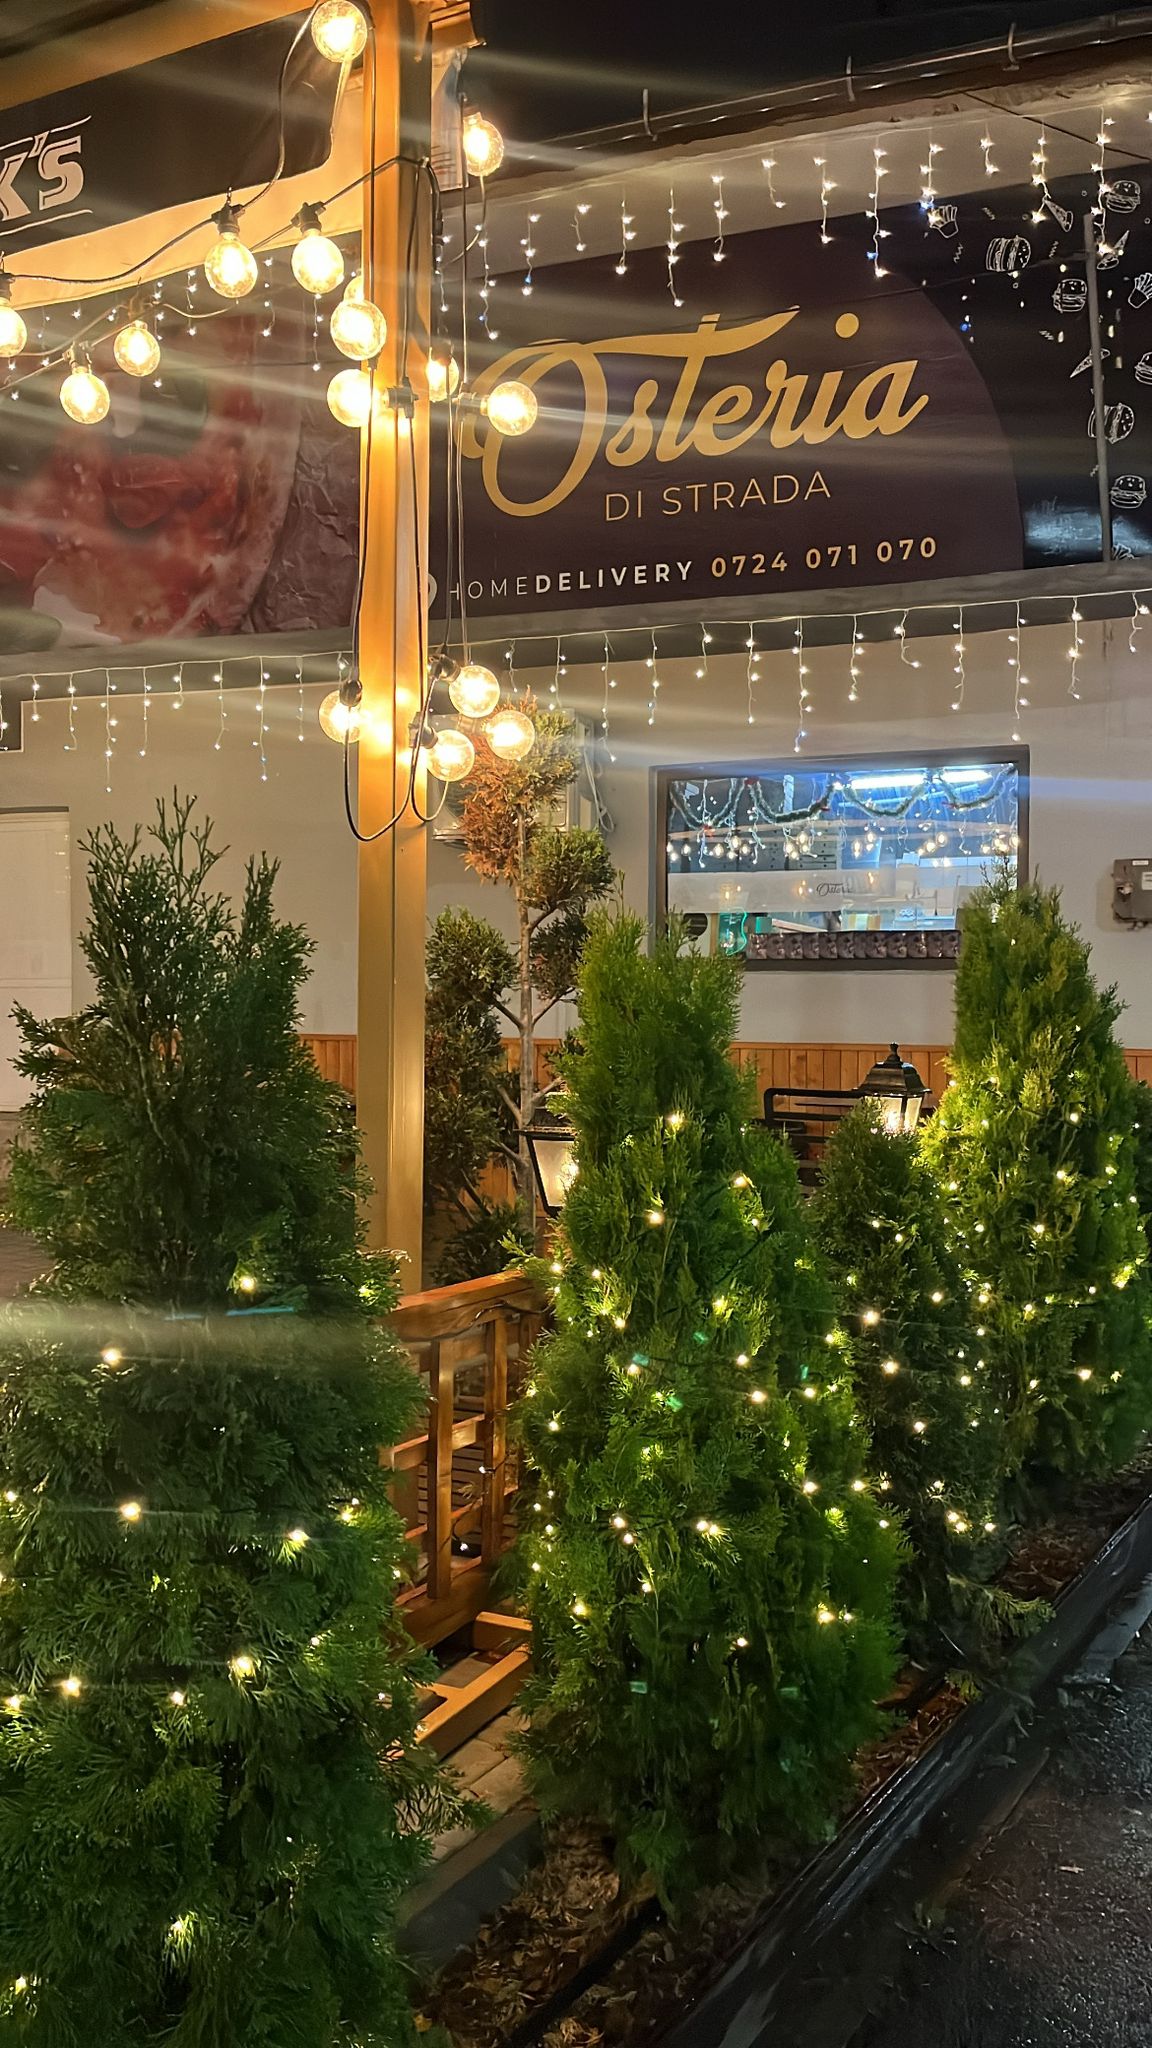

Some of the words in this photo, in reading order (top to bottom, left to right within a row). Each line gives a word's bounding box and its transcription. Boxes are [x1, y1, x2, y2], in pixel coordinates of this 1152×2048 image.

[454, 306, 928, 516] Osteria
[605, 489, 642, 521] DI
[662, 470, 831, 515] STRADA
[711, 551, 788, 578] 0724
[805, 544, 857, 569] 071
[876, 536, 937, 563] 070
